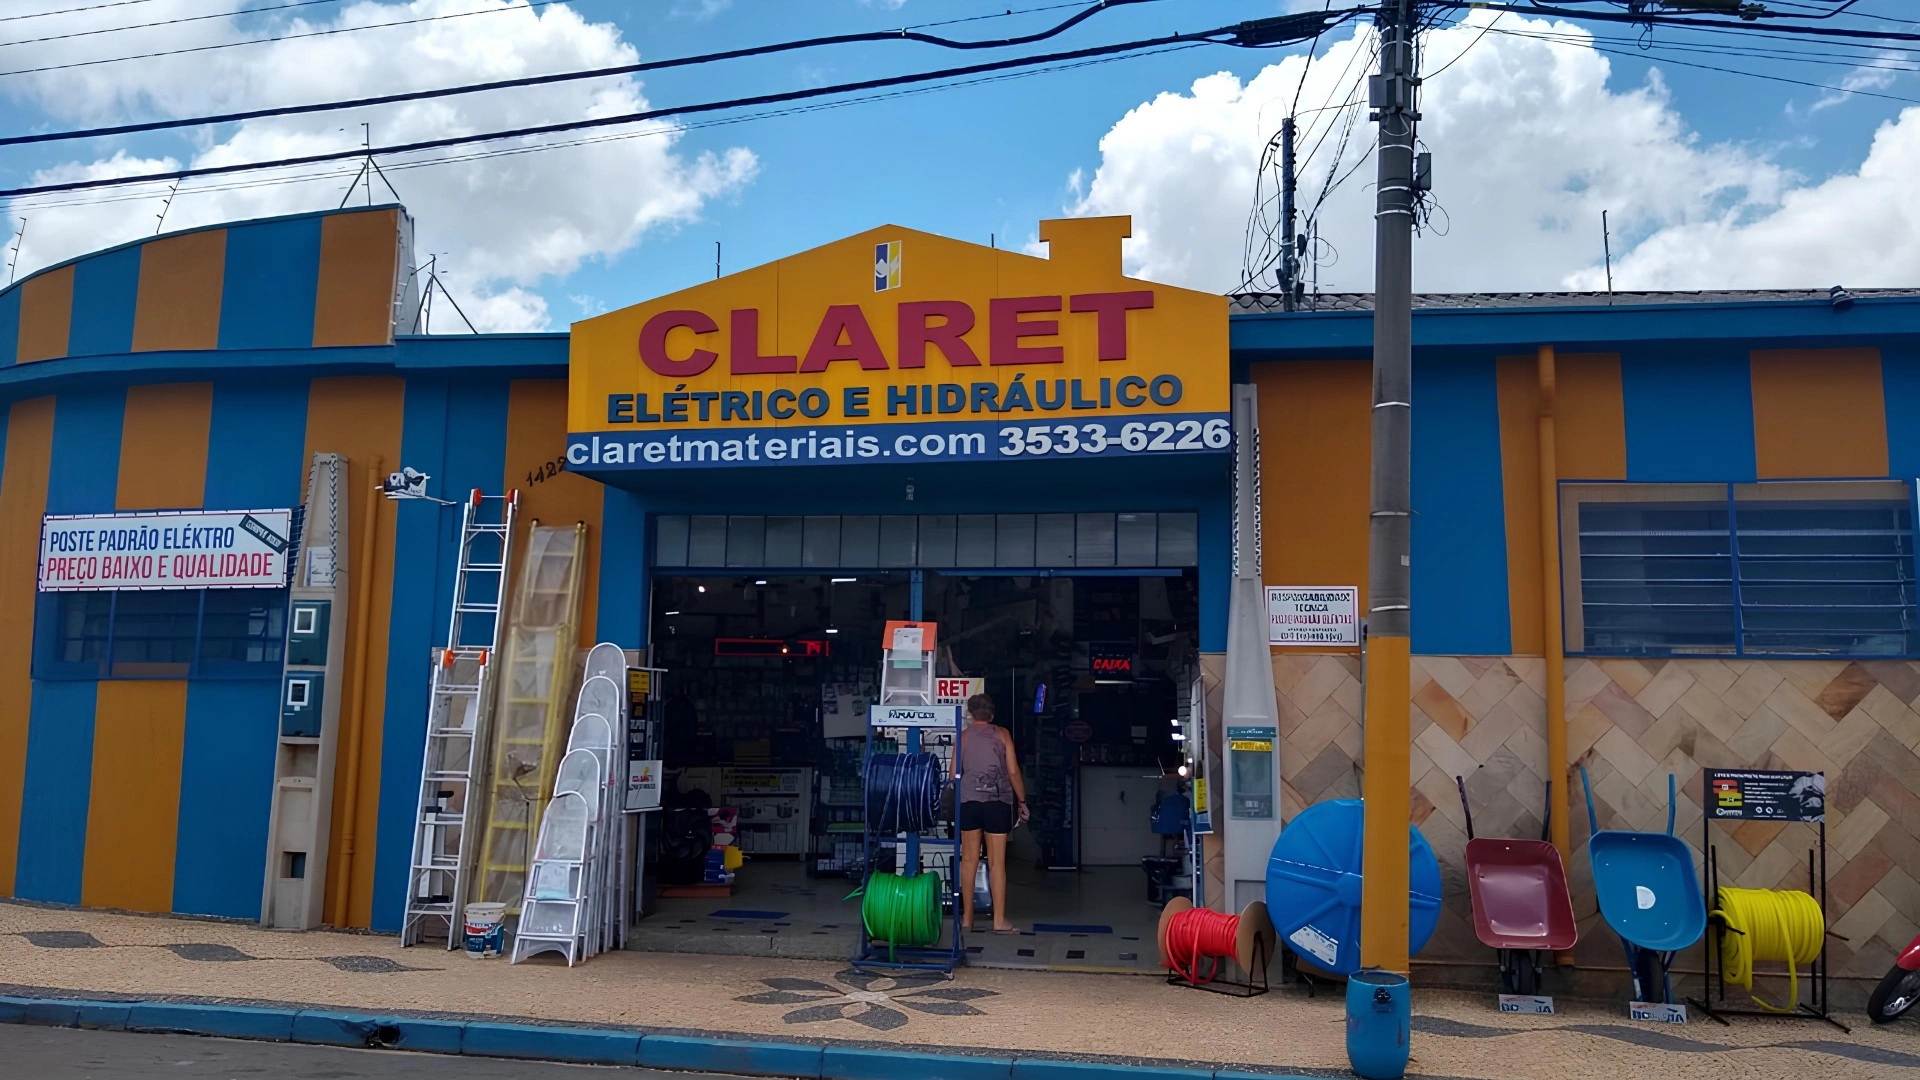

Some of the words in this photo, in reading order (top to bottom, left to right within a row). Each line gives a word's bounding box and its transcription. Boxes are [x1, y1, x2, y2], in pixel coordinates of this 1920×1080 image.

[638, 290, 1154, 377] CLARET
[608, 383, 830, 423] ELÉTRICO
[843, 386, 870, 417] E
[886, 373, 1183, 415] HIDRÁULICO
[566, 430, 986, 466] claretmateriais.com
[999, 418, 1231, 456] 3533-6226
[49, 530, 95, 553] POSTE
[99, 525, 159, 552] PADRÃO
[163, 523, 235, 550] ELÉKTRO
[46, 556, 97, 584] PREÇO
[101, 554, 153, 580] BAIXO
[158, 555, 169, 579] E
[173, 552, 275, 580] QUALIDADE
[1093, 658, 1131, 671] CAIXA
[936, 680, 970, 697] RET
